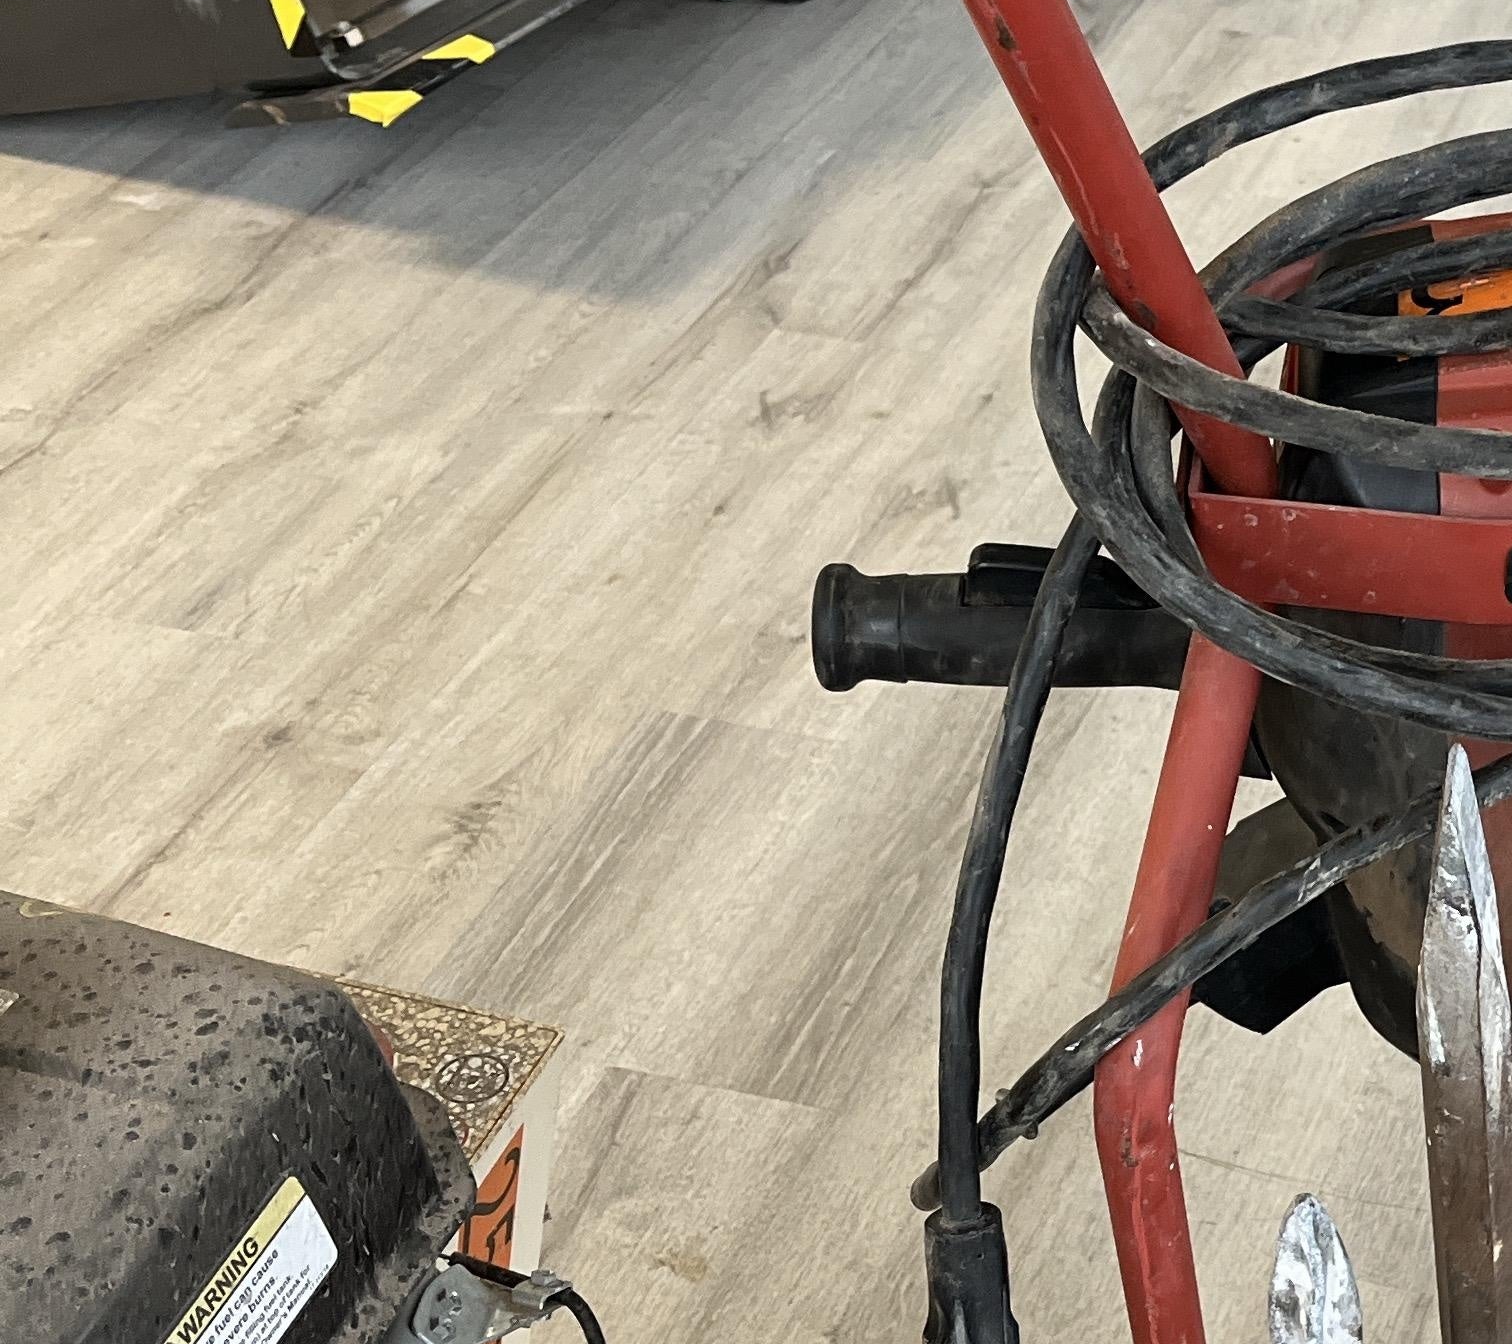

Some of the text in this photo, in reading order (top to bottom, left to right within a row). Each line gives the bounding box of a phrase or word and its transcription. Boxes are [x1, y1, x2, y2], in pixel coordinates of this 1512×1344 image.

[178, 1236, 259, 1343] WARNING
[214, 1307, 235, 1334] fuel
[237, 1285, 252, 1304] can
[251, 1249, 278, 1285] cause
